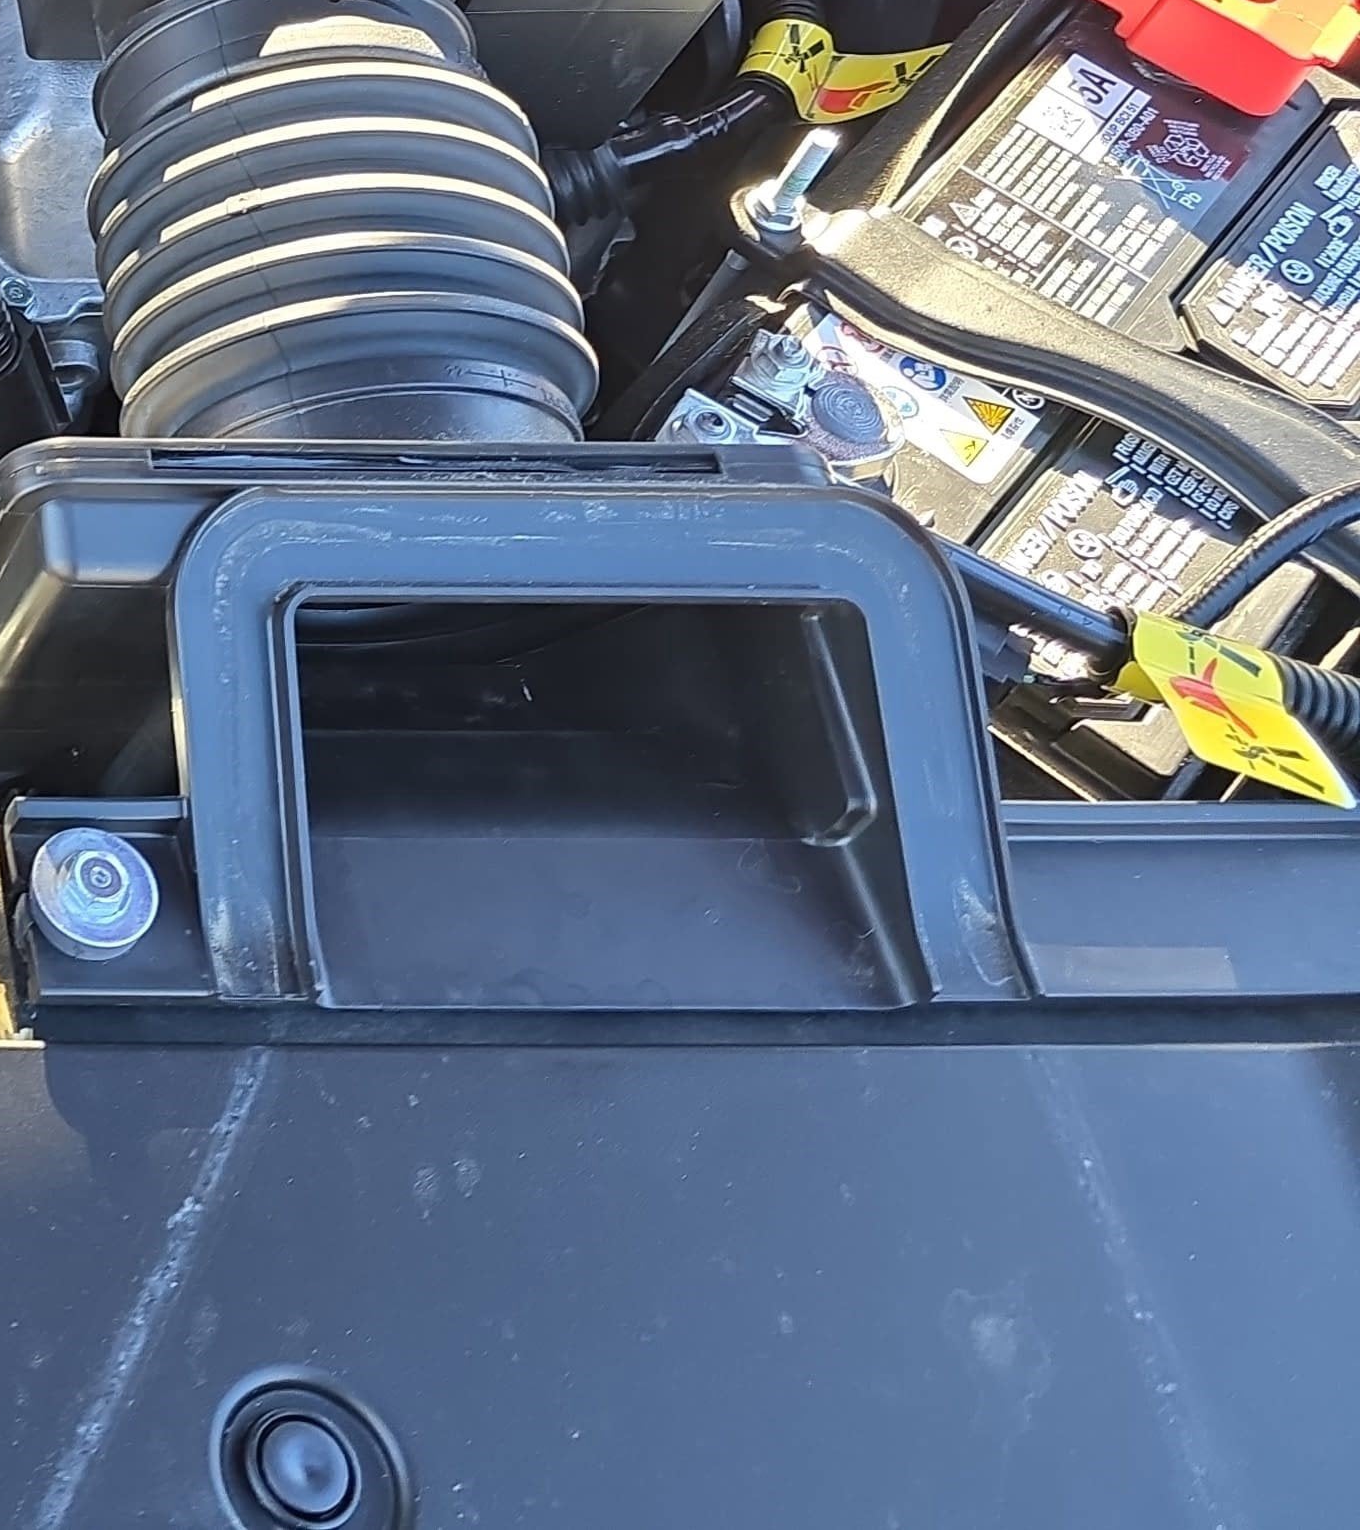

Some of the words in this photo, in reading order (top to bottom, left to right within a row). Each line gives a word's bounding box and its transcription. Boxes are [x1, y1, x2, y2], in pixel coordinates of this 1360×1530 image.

[1068, 65, 1117, 106] 5A
[1125, 100, 1140, 113] 51
[1176, 191, 1203, 210] Pb
